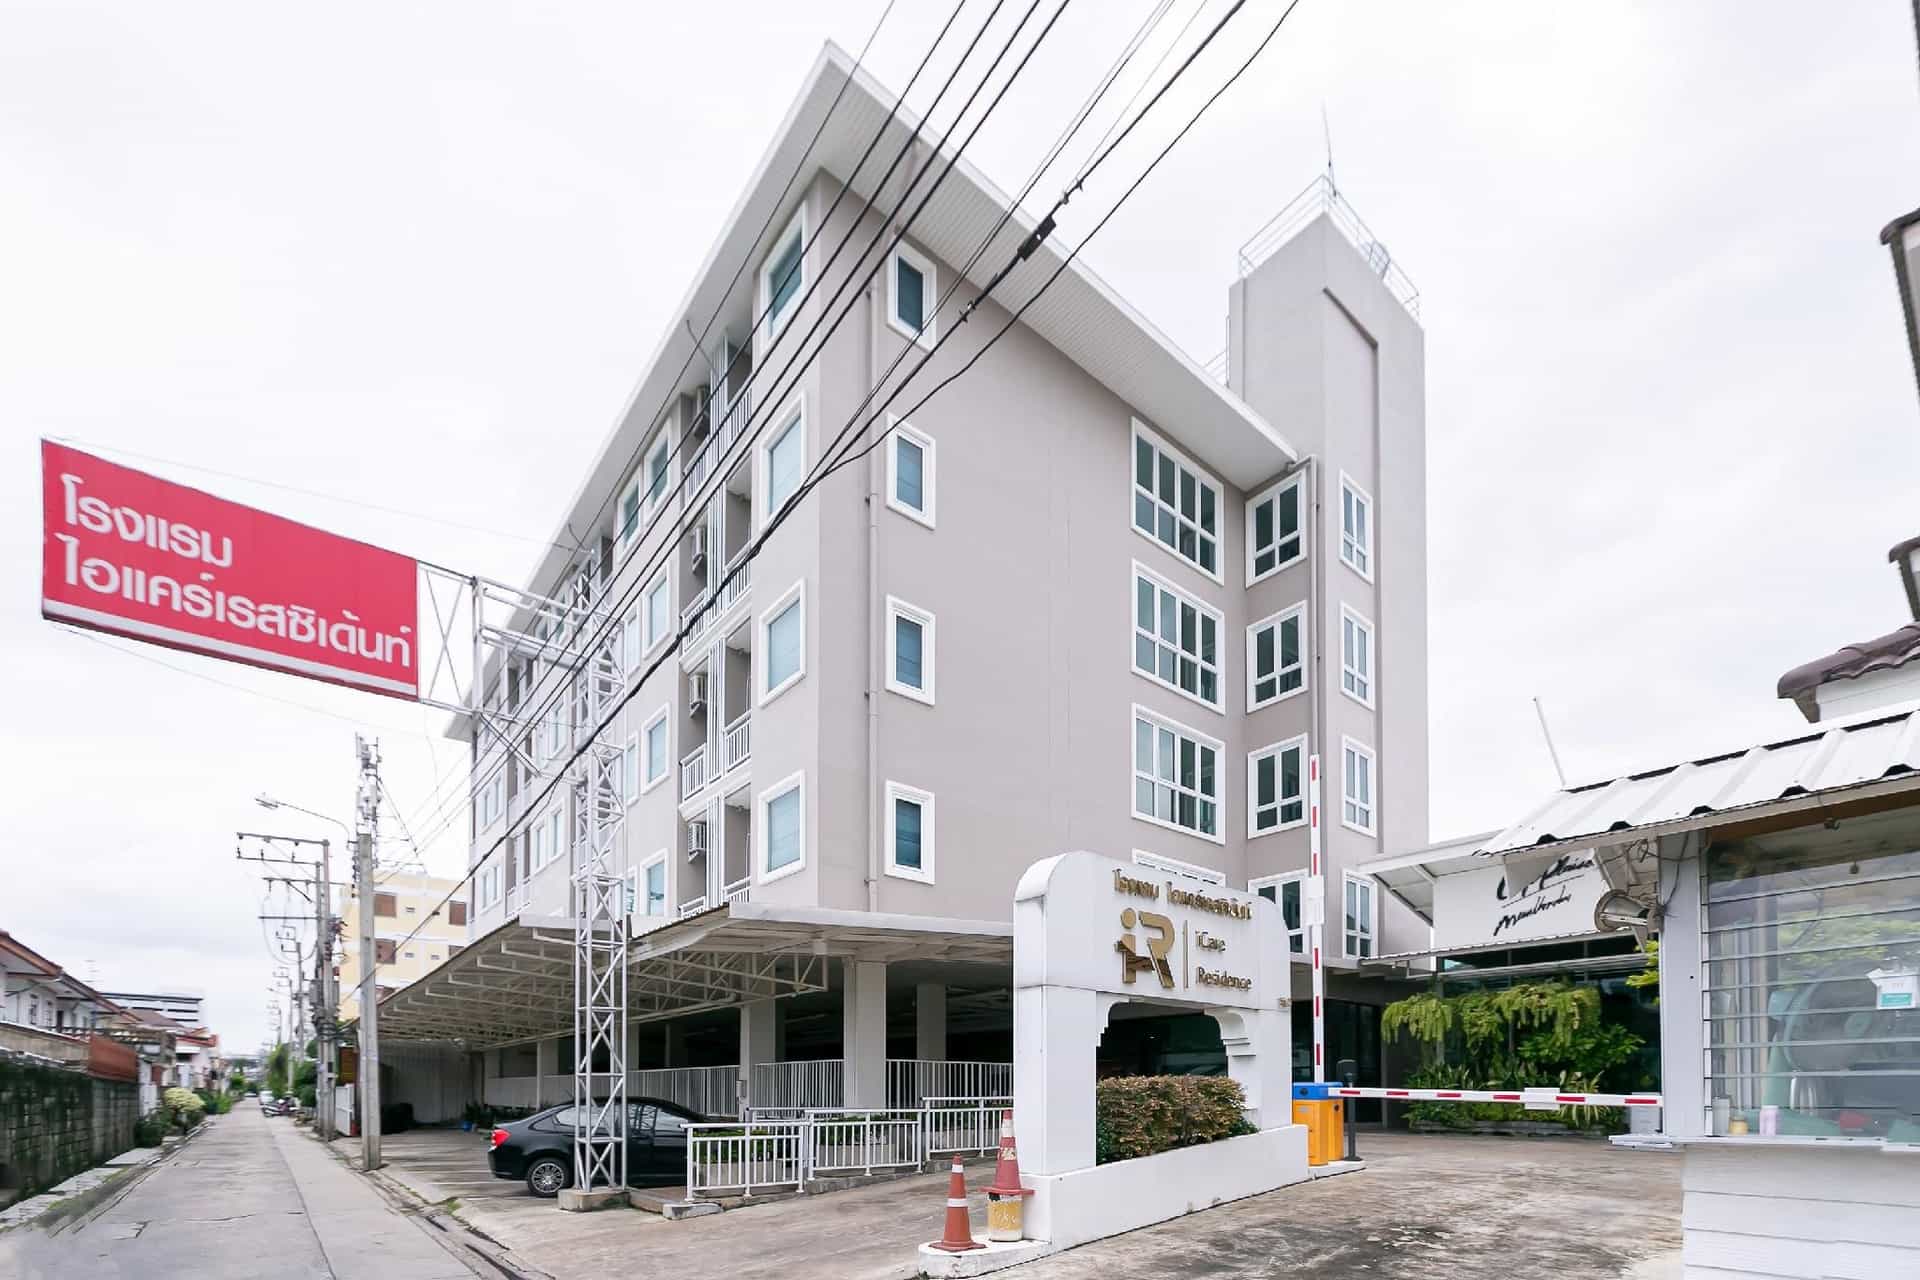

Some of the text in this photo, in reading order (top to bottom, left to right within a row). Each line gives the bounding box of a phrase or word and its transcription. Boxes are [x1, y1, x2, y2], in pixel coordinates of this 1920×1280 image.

[60, 473, 233, 568] โรงแรม
[1196, 966, 1252, 991] Residence
